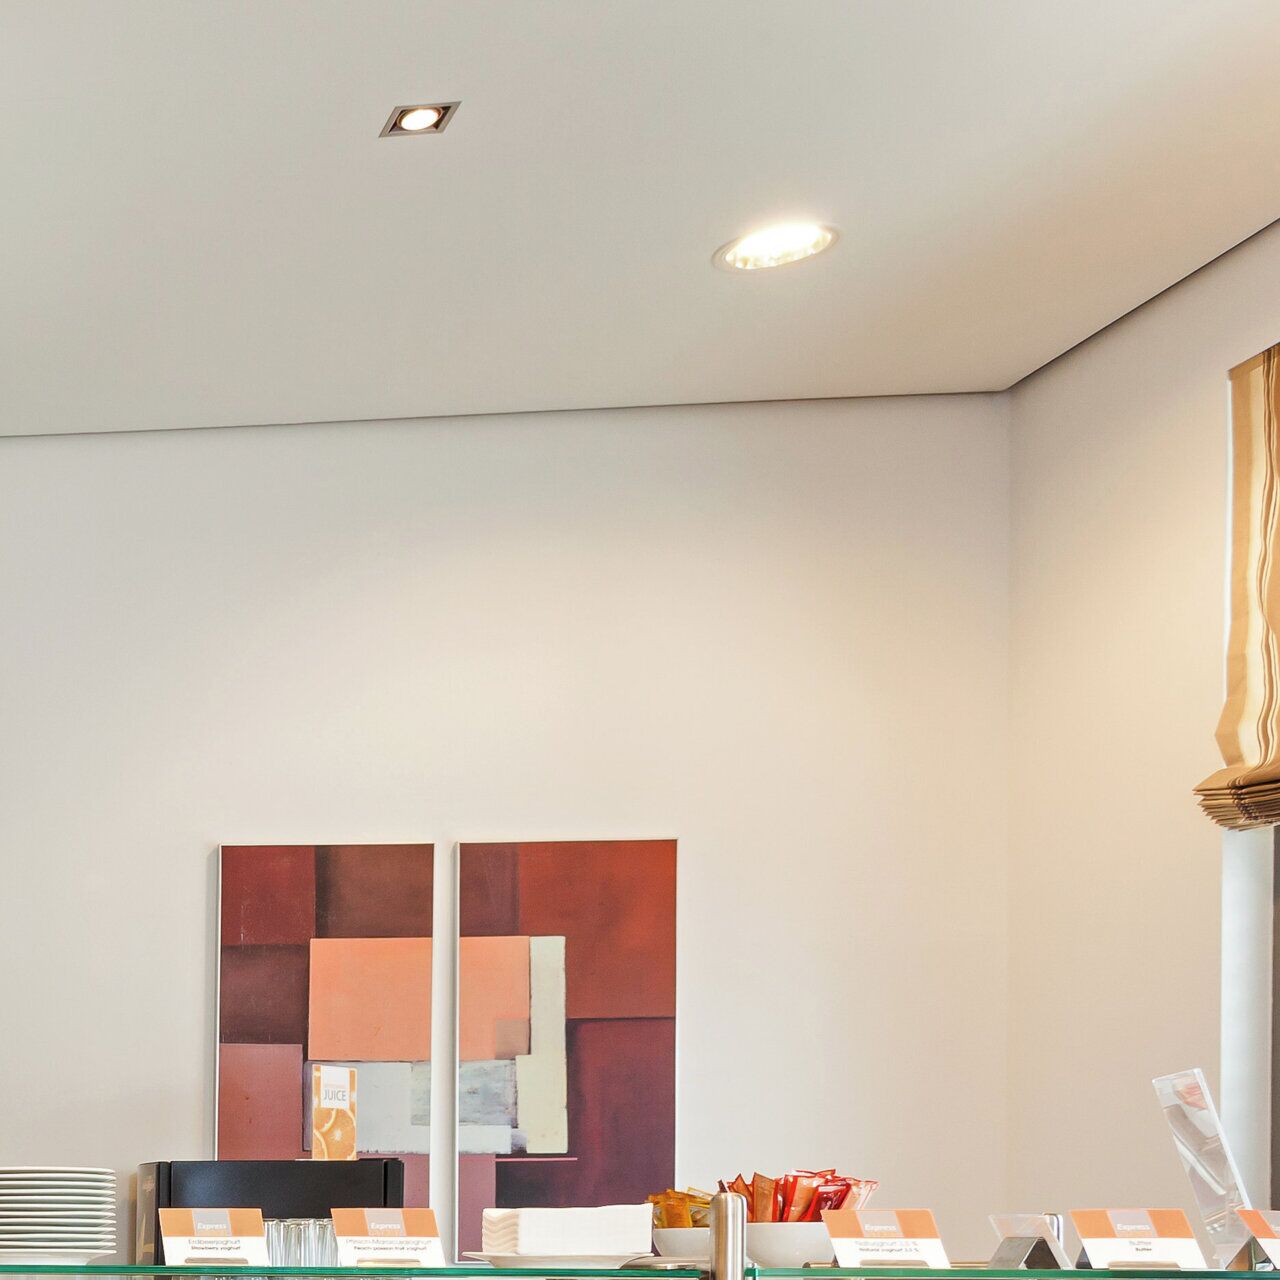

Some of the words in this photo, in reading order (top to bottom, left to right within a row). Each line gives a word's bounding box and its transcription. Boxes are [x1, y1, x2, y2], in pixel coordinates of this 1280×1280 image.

[323, 1089, 347, 1101] JUICE
[197, 1222, 227, 1231] Express
[370, 1222, 401, 1231] Express
[864, 1223, 897, 1232] Express
[1116, 1223, 1152, 1232] Express
